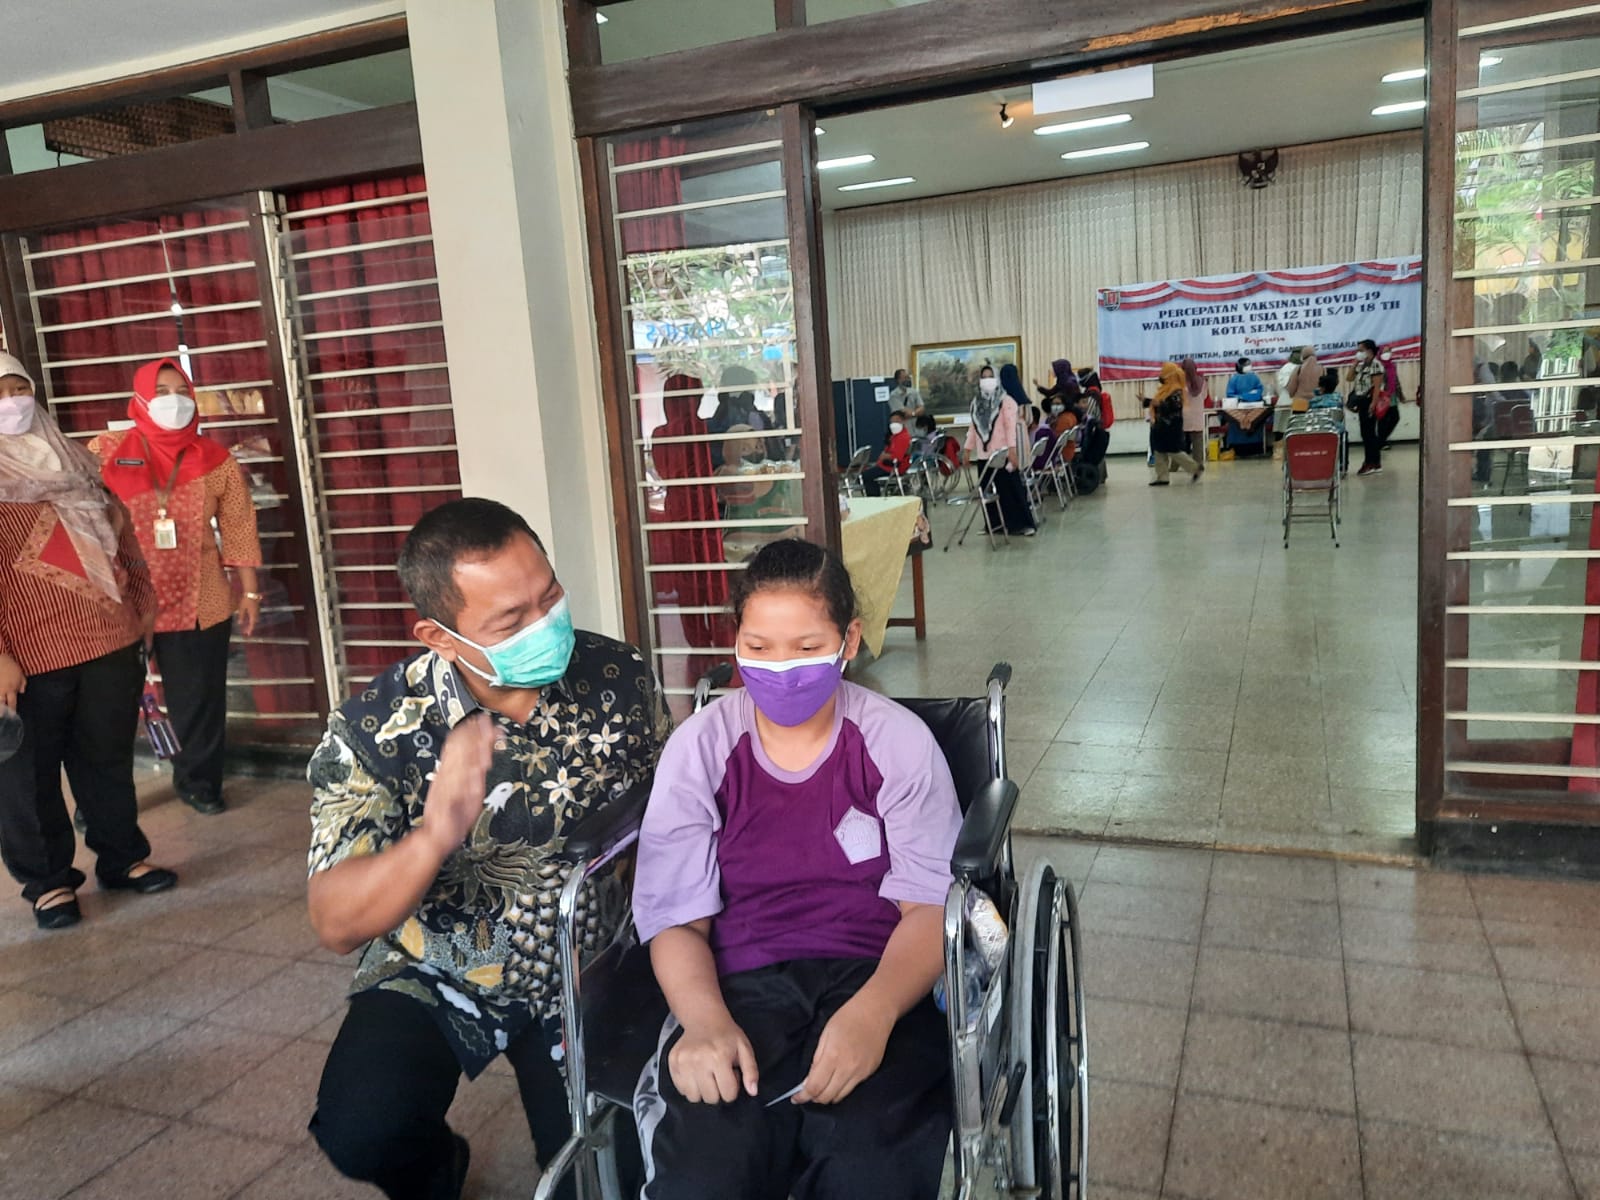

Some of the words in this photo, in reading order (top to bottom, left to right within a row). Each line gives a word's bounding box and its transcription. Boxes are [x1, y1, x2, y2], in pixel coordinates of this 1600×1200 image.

[1142, 319, 1187, 331] WARGA
[1191, 314, 1246, 327] DIFABEL
[1249, 312, 1278, 321] USIA
[1283, 310, 1299, 319] 12
[1303, 307, 1322, 318] TH
[1327, 304, 1354, 316] S/D
[1360, 302, 1375, 312] 18
[1380, 300, 1401, 311] TH
[1159, 302, 1238, 319] PERCEPATAN
[1243, 296, 1310, 312] VAKSINASI
[1315, 290, 1381, 305] COVID-19
[1211, 324, 1246, 336] KOTA
[1250, 319, 1322, 333] SEMARANG
